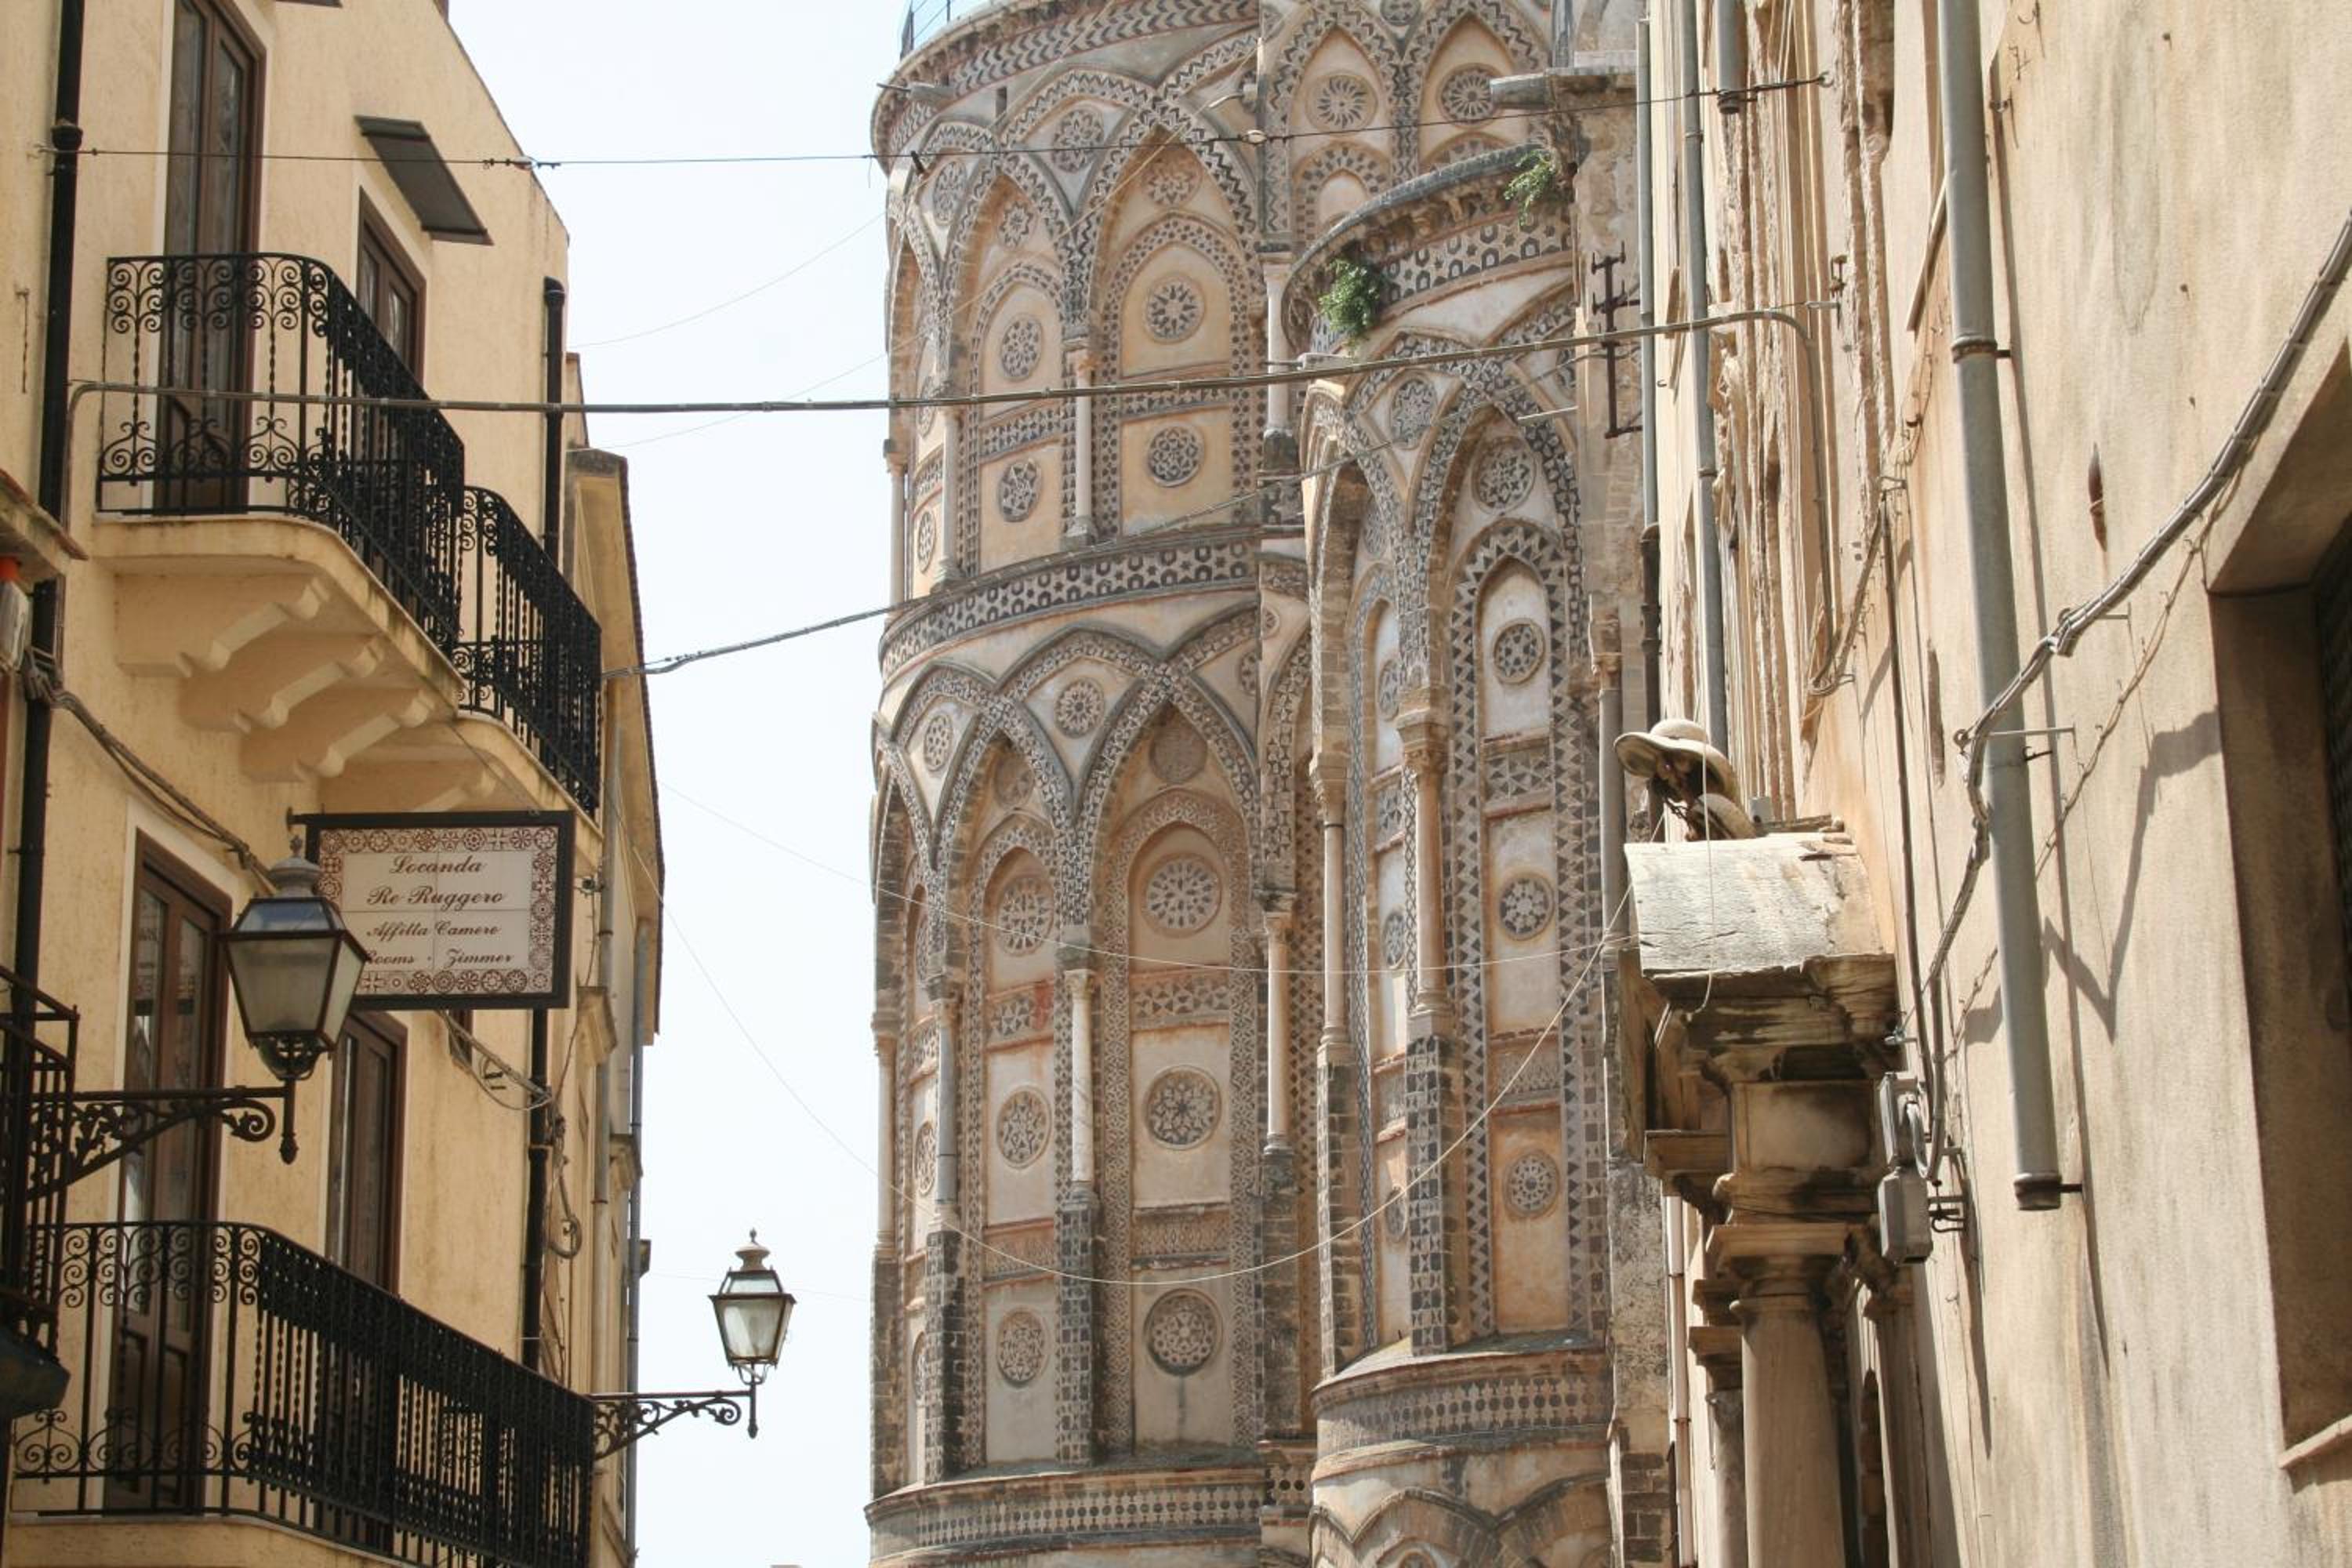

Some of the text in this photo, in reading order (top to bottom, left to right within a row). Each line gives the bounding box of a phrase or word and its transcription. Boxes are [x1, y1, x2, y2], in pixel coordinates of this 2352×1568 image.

[389, 855, 486, 873] Locanda
[366, 885, 503, 912] Re Ruggero
[366, 920, 499, 941] Affitta Camere
[445, 948, 514, 970] Zimmer
